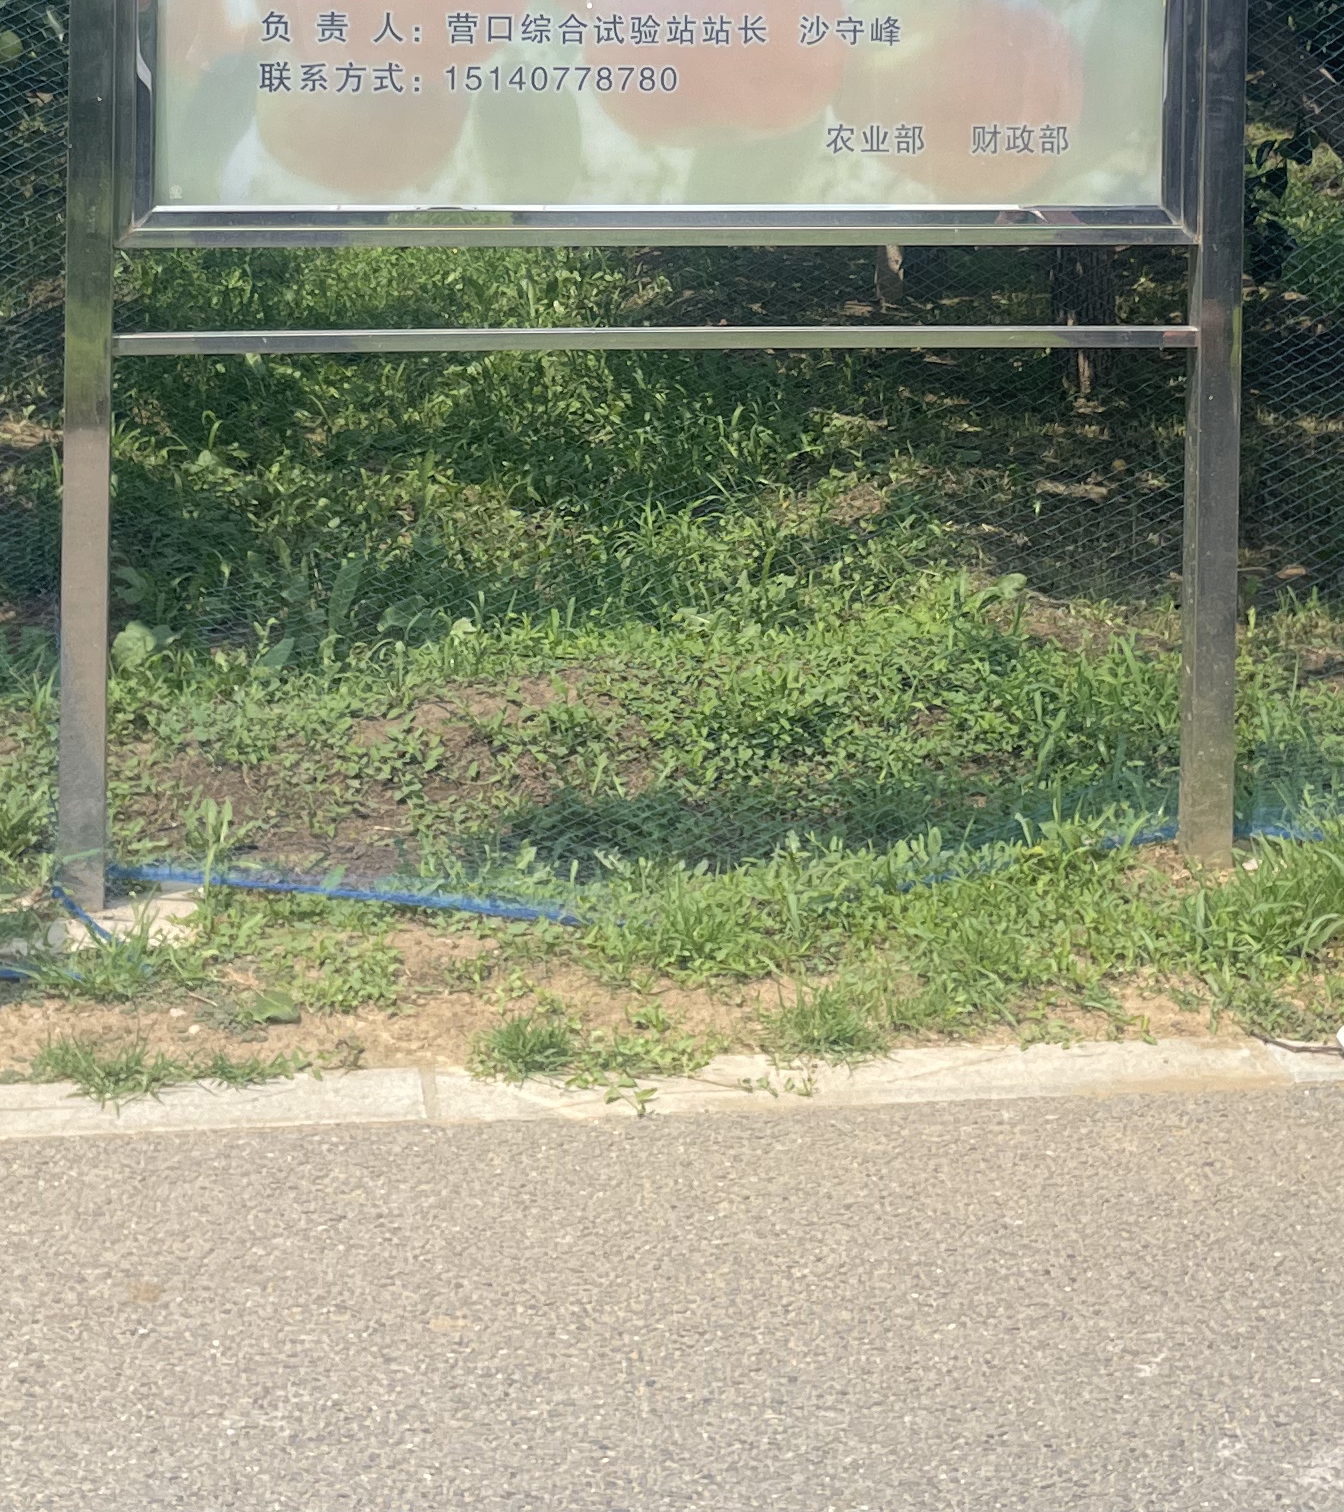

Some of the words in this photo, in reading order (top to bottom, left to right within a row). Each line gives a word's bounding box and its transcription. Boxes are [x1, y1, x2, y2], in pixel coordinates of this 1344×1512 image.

[826, 123, 926, 156] 农业部
[970, 123, 1070, 156] 财政部
